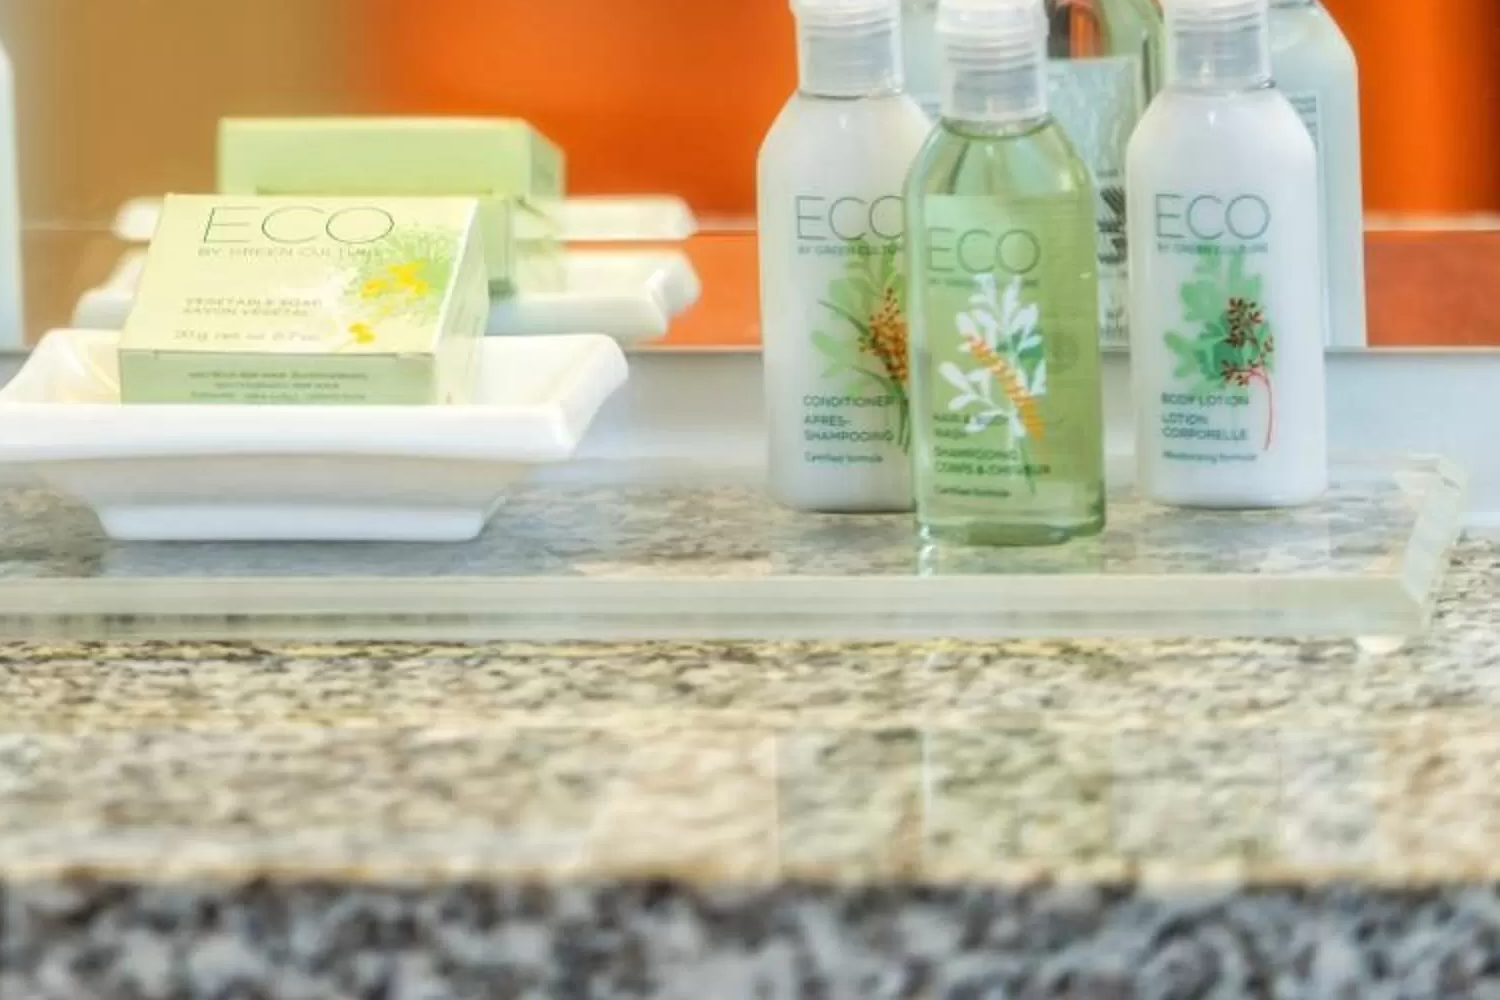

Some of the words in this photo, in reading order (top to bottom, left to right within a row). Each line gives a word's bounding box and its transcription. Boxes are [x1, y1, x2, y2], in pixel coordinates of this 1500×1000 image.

[203, 204, 396, 244] ECO
[795, 194, 905, 241] ECO
[1155, 193, 1272, 241] ECO
[197, 247, 221, 257] BY
[927, 226, 1041, 275] ECO
[803, 395, 896, 408] CONDITIONER
[804, 430, 895, 442] SHAMPOOING
